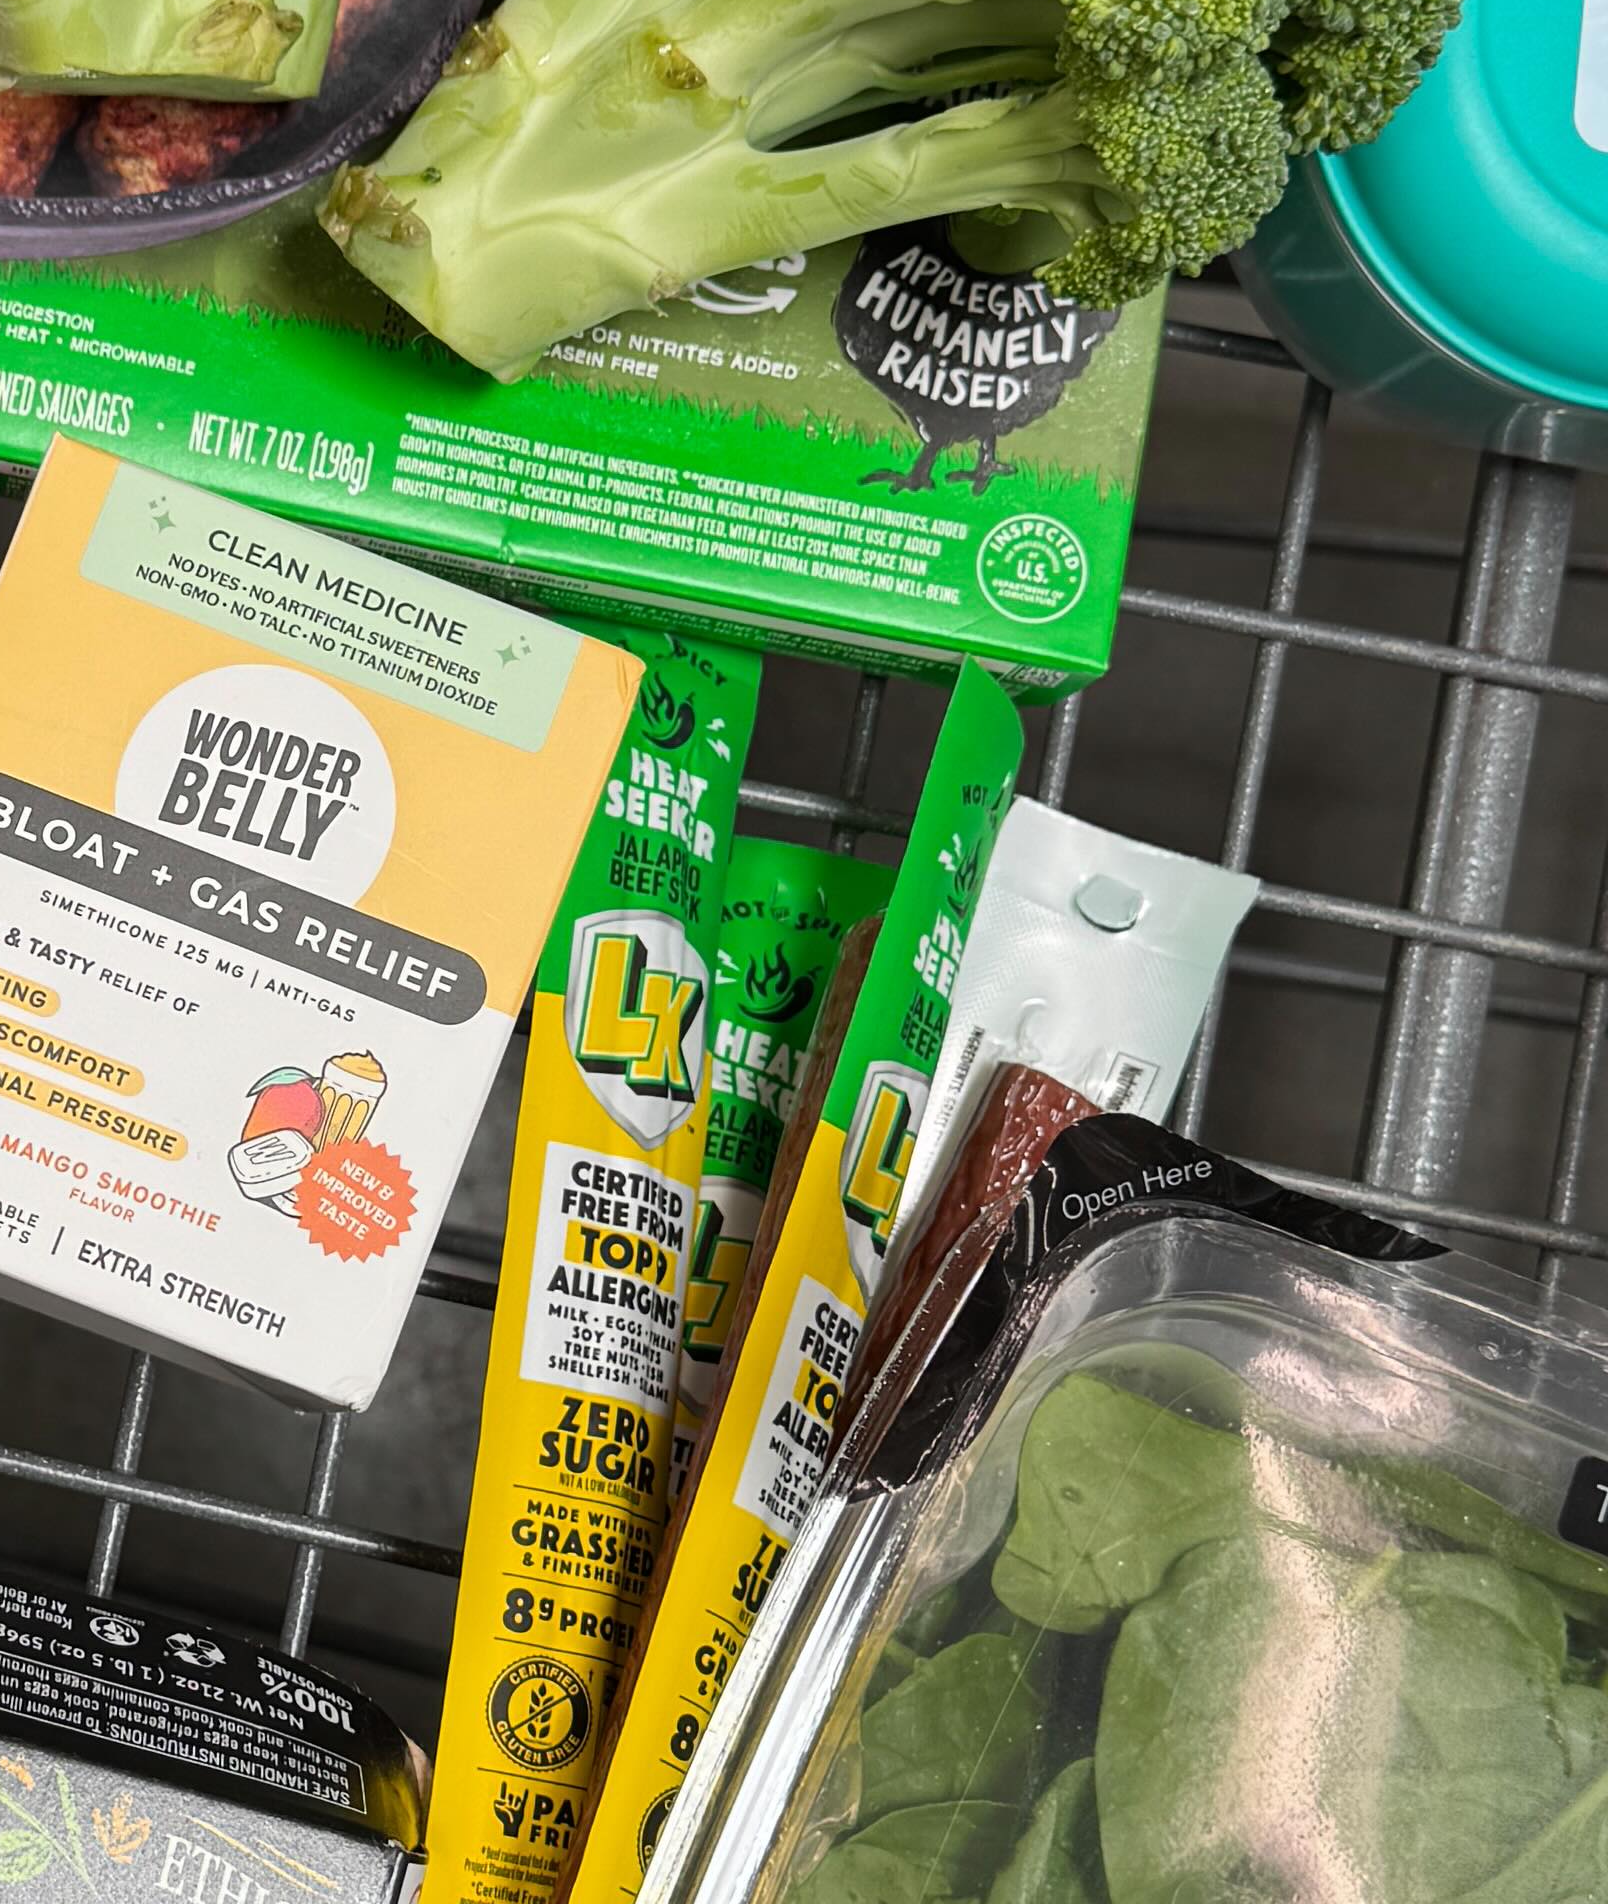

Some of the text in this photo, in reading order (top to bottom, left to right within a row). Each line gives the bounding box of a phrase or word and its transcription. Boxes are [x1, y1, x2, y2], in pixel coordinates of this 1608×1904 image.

[886, 246, 1074, 322] APPLEGAT
[6, 323, 50, 345] HEAT
[70, 336, 196, 376] MICROWAVABLE
[857, 270, 1080, 367] HUMANELY
[611, 357, 659, 379] FREE
[628, 334, 798, 382] NITRITES ADDED
[35, 376, 134, 437] SAUSAGES
[189, 409, 374, 495] NET WT. 7 OZ. (198g)
[989, 518, 1082, 571] INSPECTED
[1016, 561, 1049, 584] U.S.
[169, 552, 480, 686] NO DYES NO ARTIFICIAL SWEETENERS
[208, 529, 468, 646] CLEAN MEDICINE
[136, 565, 498, 716] NON-GMO NO TALC NO TITANIUM DIOXIDE
[183, 708, 362, 797] WONDER
[629, 747, 708, 810] HEAT
[605, 780, 715, 863] SEEKER
[39, 890, 357, 1024] SIMETHICONE 125 MG ANTI-GAS
[188, 874, 280, 935] GAS
[294, 915, 458, 999] RELIEF
[29, 935, 96, 976] TASTY
[100, 967, 166, 1005] RELIEF
[174, 994, 200, 1018] OF
[47, 1088, 178, 1155] PRESSURE
[0, 1132, 221, 1233] MANGO SMOOTHIE
[313, 1167, 396, 1232] IMPROVED
[339, 1155, 377, 1188] NEW
[1062, 1157, 1214, 1222] Open Here
[69, 1187, 134, 1224] FLAVOR
[316, 1195, 369, 1242] TASTE
[561, 1188, 628, 1230] FREE
[77, 1238, 286, 1338] EXTRA STRENGTH
[561, 1395, 649, 1451] ZERO
[539, 1432, 655, 1497] SUGAR
[257, 1655, 353, 1711] COMPOSTABLE
[105, 1721, 351, 1806] SAFE HANDLING INSTRUCTIONS:
